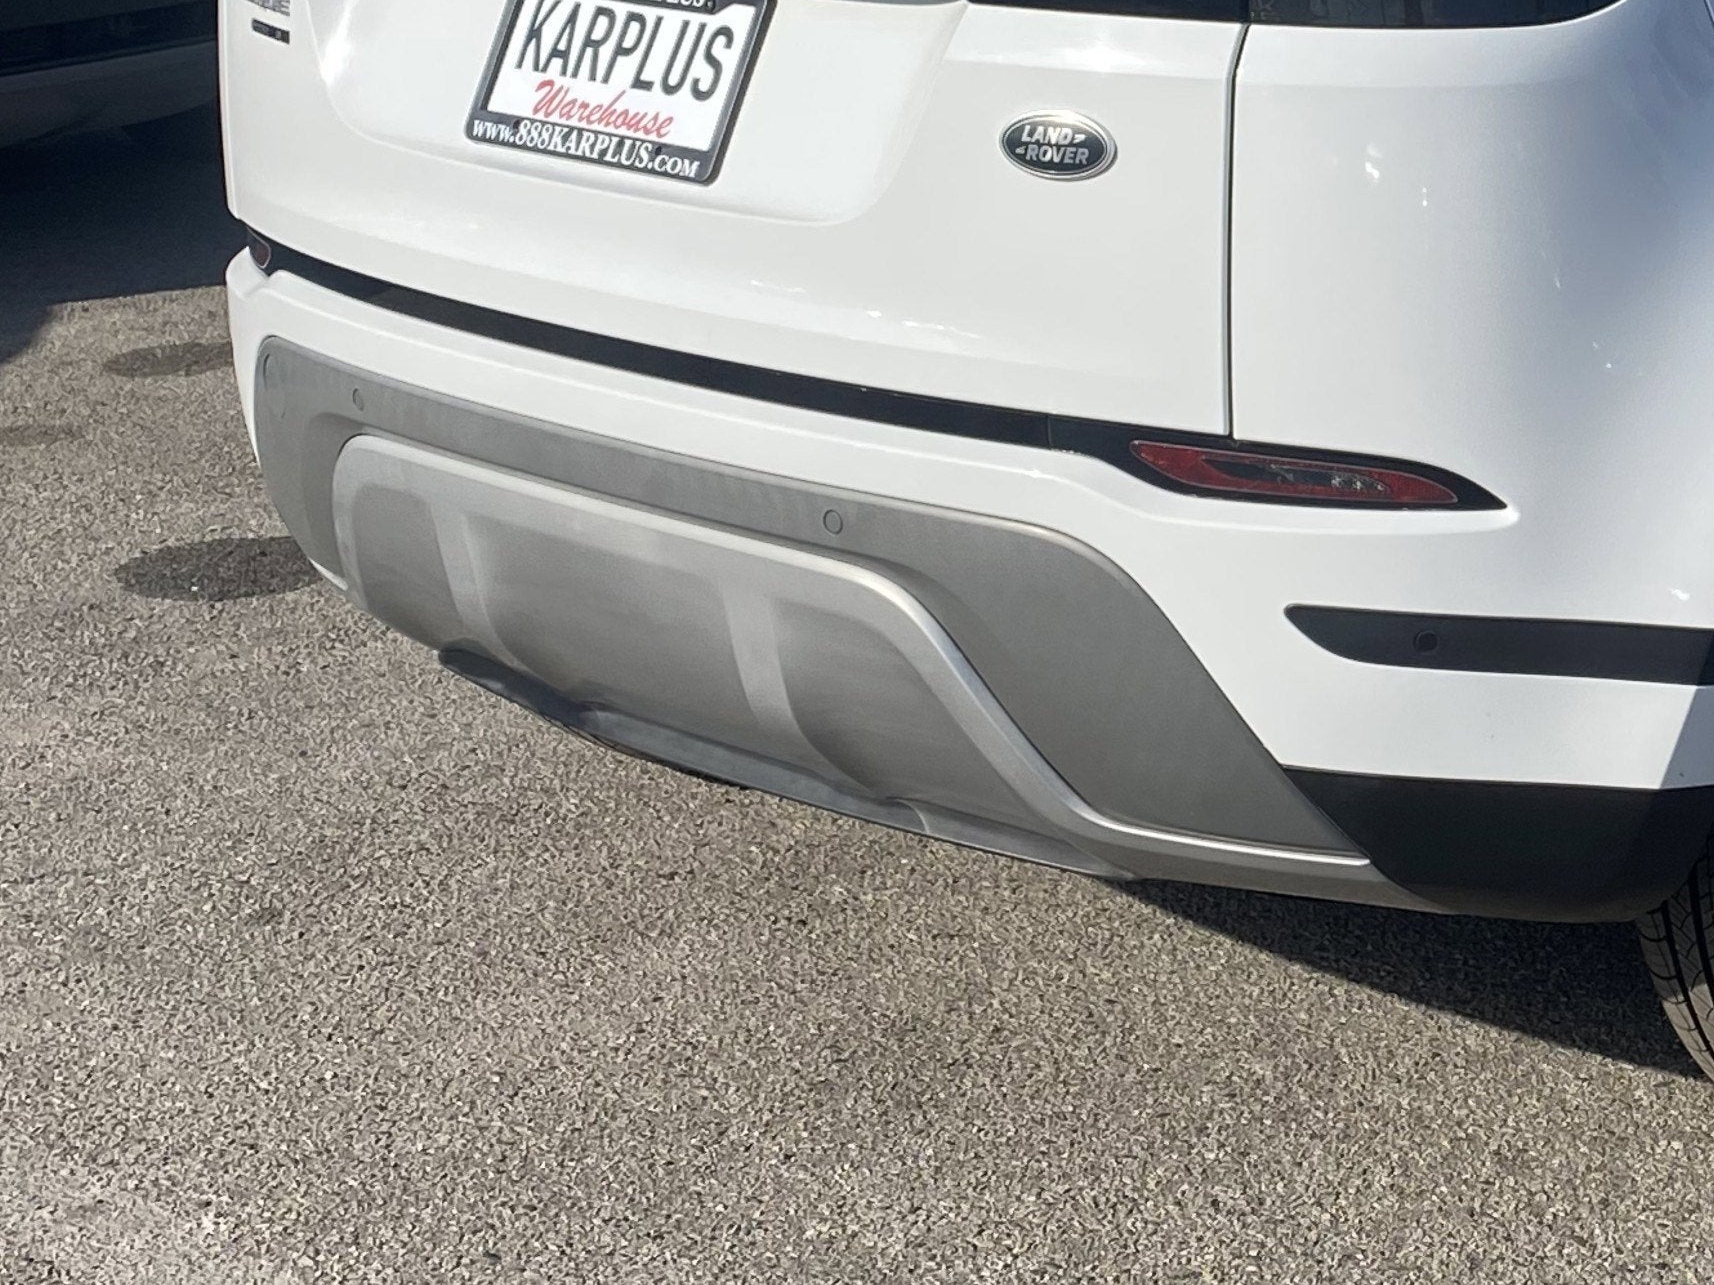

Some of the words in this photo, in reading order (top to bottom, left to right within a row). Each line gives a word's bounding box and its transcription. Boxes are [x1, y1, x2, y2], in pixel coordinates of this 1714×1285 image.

[532, 79, 674, 139] Warehouse
[1021, 125, 1073, 145] LAND
[1026, 144, 1090, 165] ROVER
